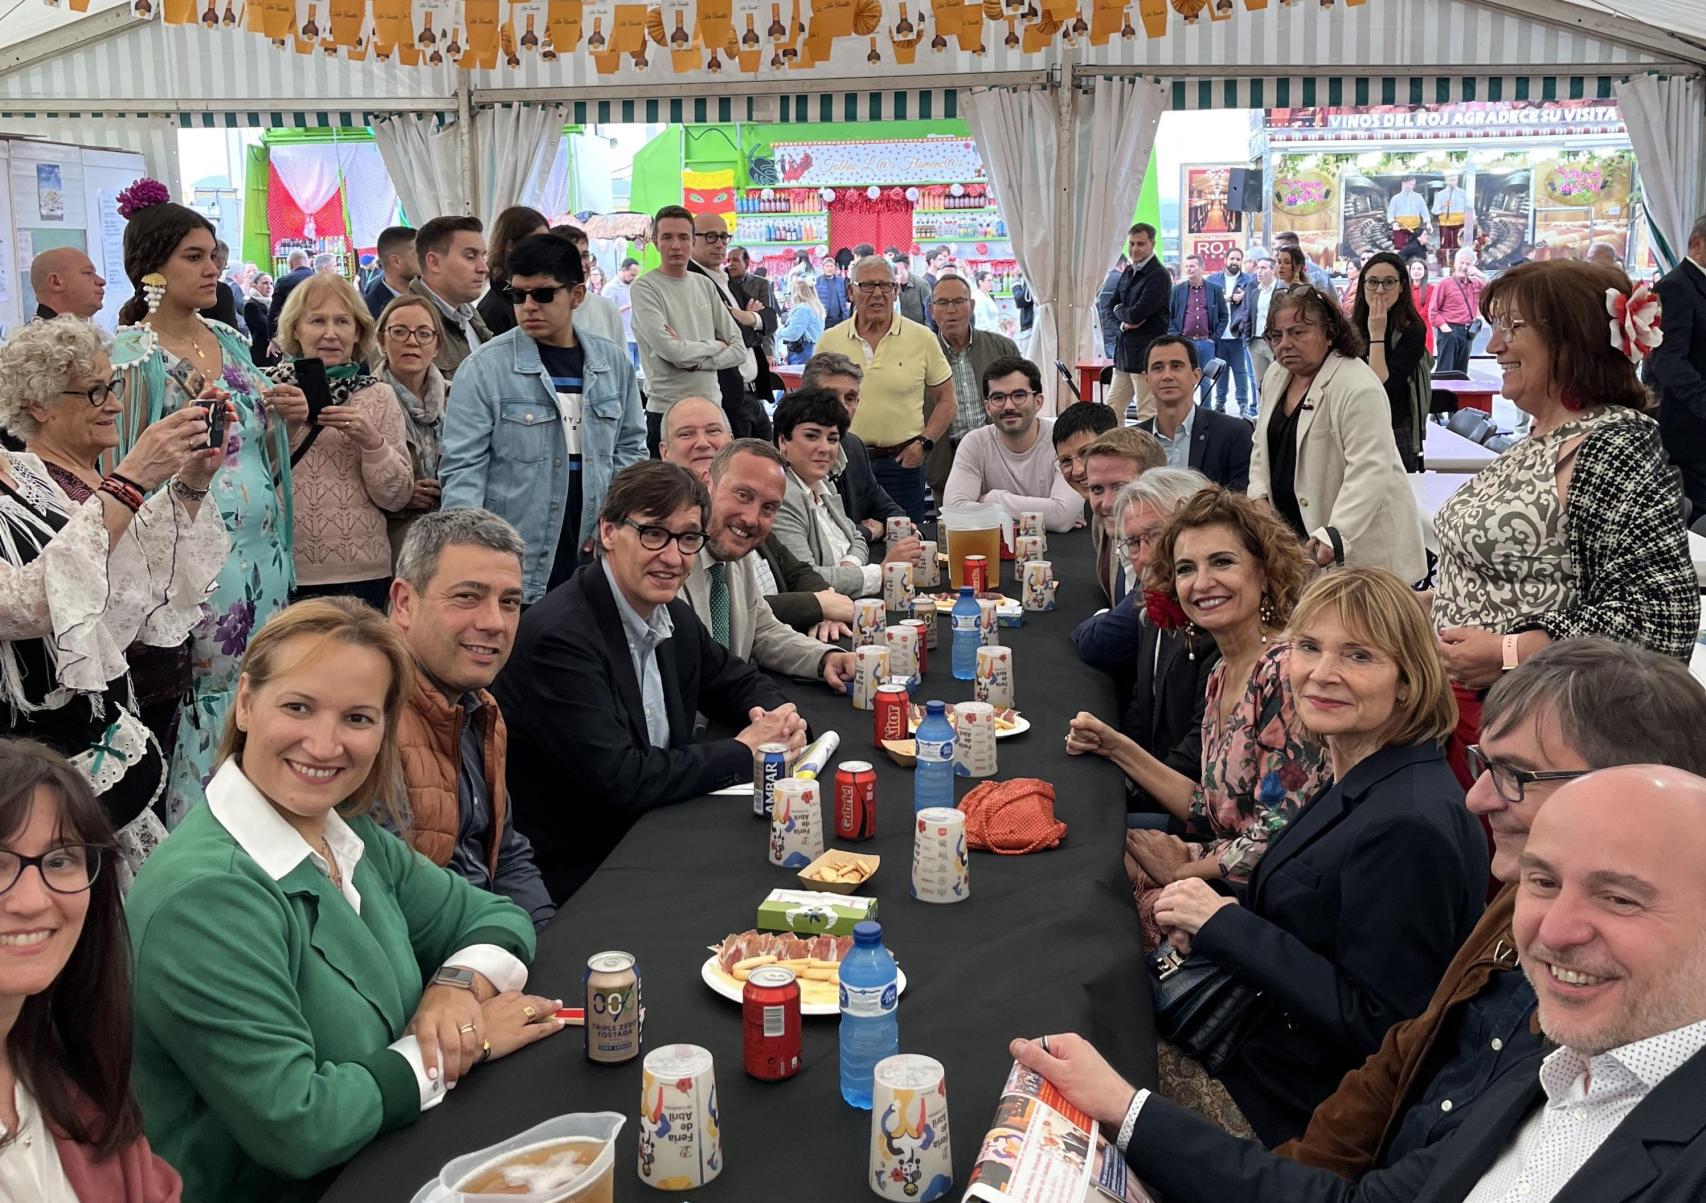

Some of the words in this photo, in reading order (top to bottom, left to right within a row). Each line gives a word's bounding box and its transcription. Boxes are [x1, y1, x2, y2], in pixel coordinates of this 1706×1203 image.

[1329, 114, 1381, 128] VINOS
[1384, 113, 1413, 127] DEL
[1416, 112, 1448, 126] ROJ
[1452, 108, 1540, 125] AGRADECE
[1541, 108, 1560, 122] SU
[1562, 106, 1618, 122] VISITA
[885, 705, 900, 740] Aitor
[765, 761, 778, 813] AMBAR
[841, 786, 854, 832] Gabriel
[592, 1023, 616, 1032] TRIPLE
[598, 1030, 632, 1038] TOSTADA
[669, 1112, 692, 1122] Abril
[680, 1122, 693, 1131] de
[668, 1133, 694, 1144] Feria
